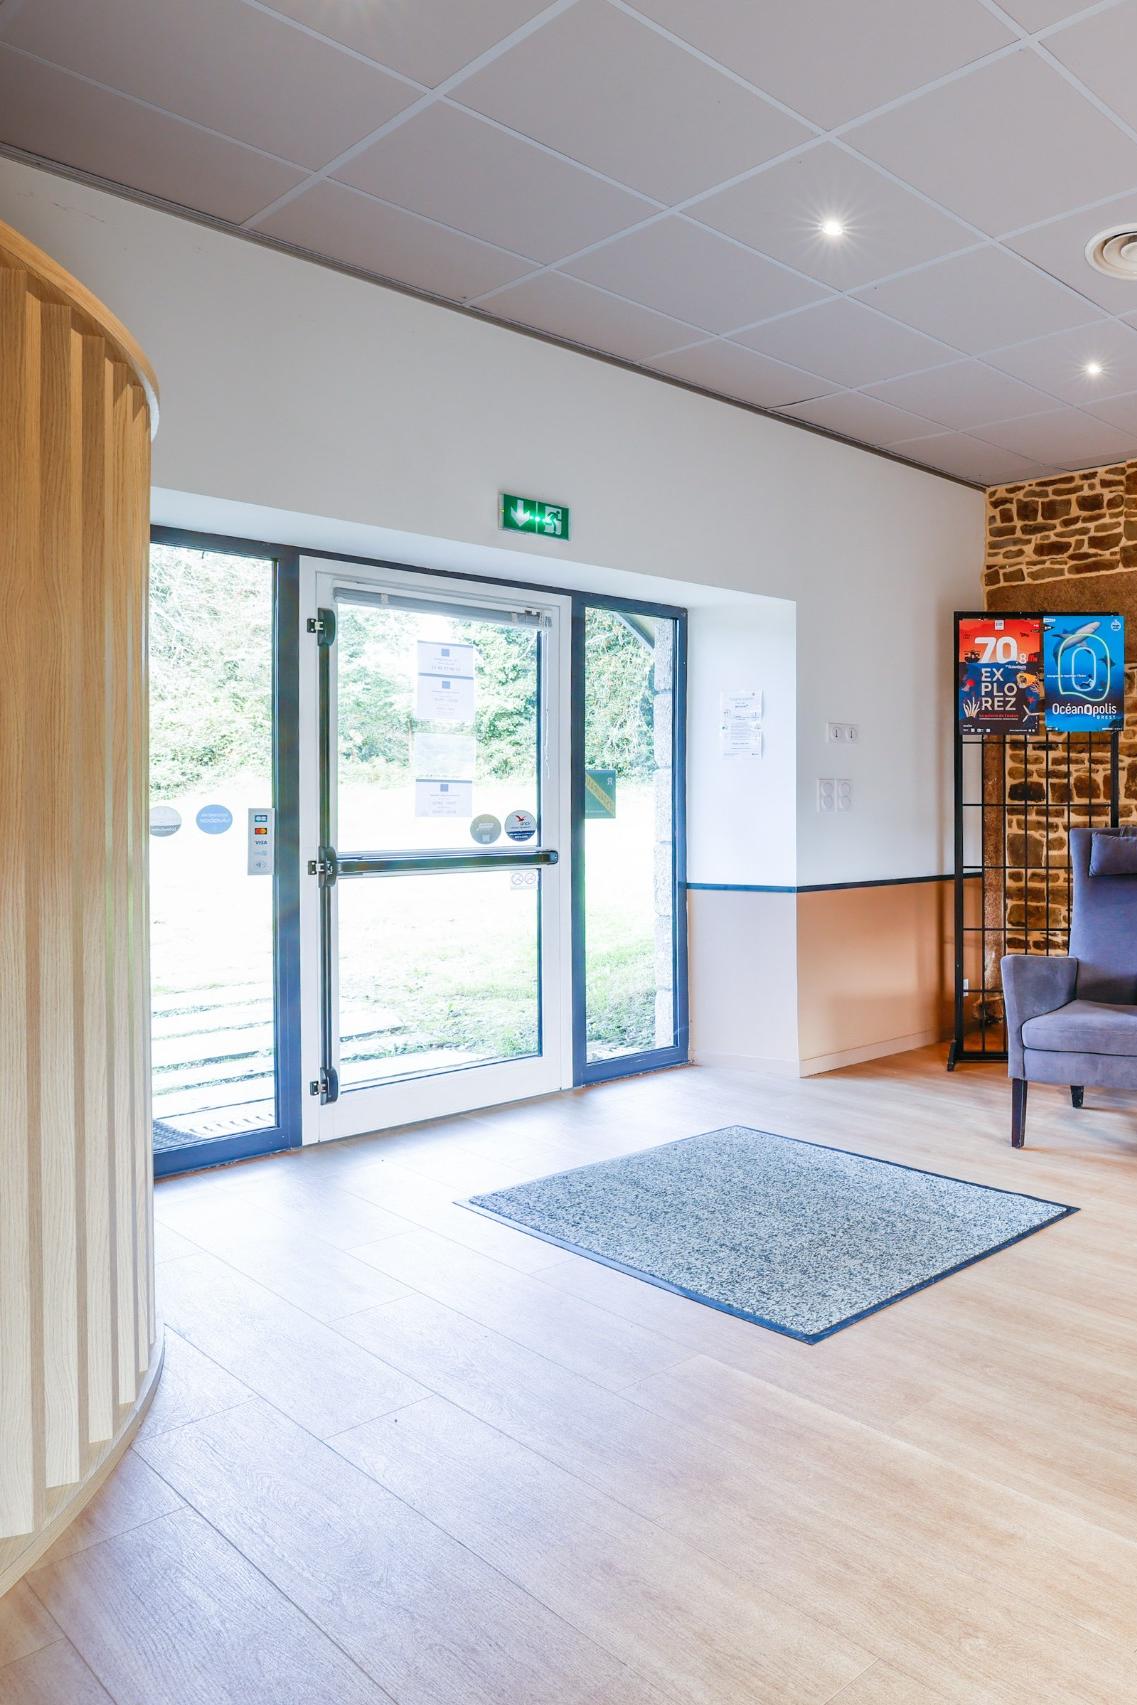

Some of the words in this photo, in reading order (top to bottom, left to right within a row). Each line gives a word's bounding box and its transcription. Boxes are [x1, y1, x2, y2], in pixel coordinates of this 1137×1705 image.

[981, 667, 1004, 682] EX
[981, 683, 1018, 696] PLO
[981, 697, 1017, 711] REZ
